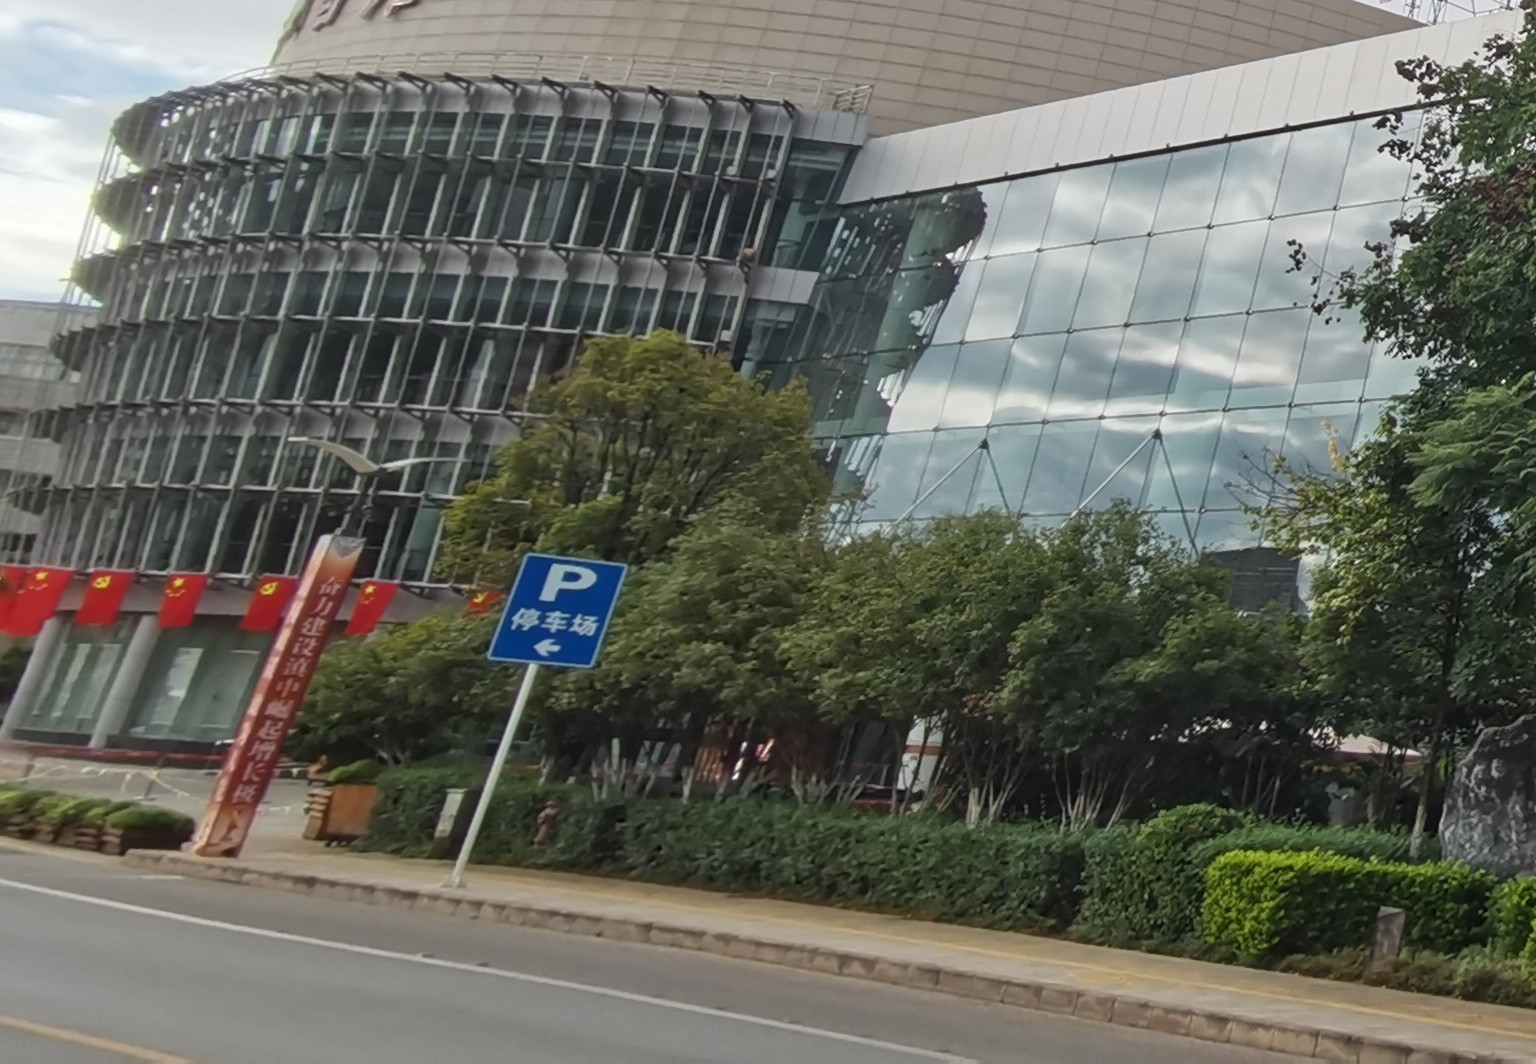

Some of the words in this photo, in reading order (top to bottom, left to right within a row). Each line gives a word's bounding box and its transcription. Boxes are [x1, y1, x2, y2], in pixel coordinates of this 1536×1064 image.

[538, 563, 597, 602] P
[510, 607, 599, 636] 停车场
